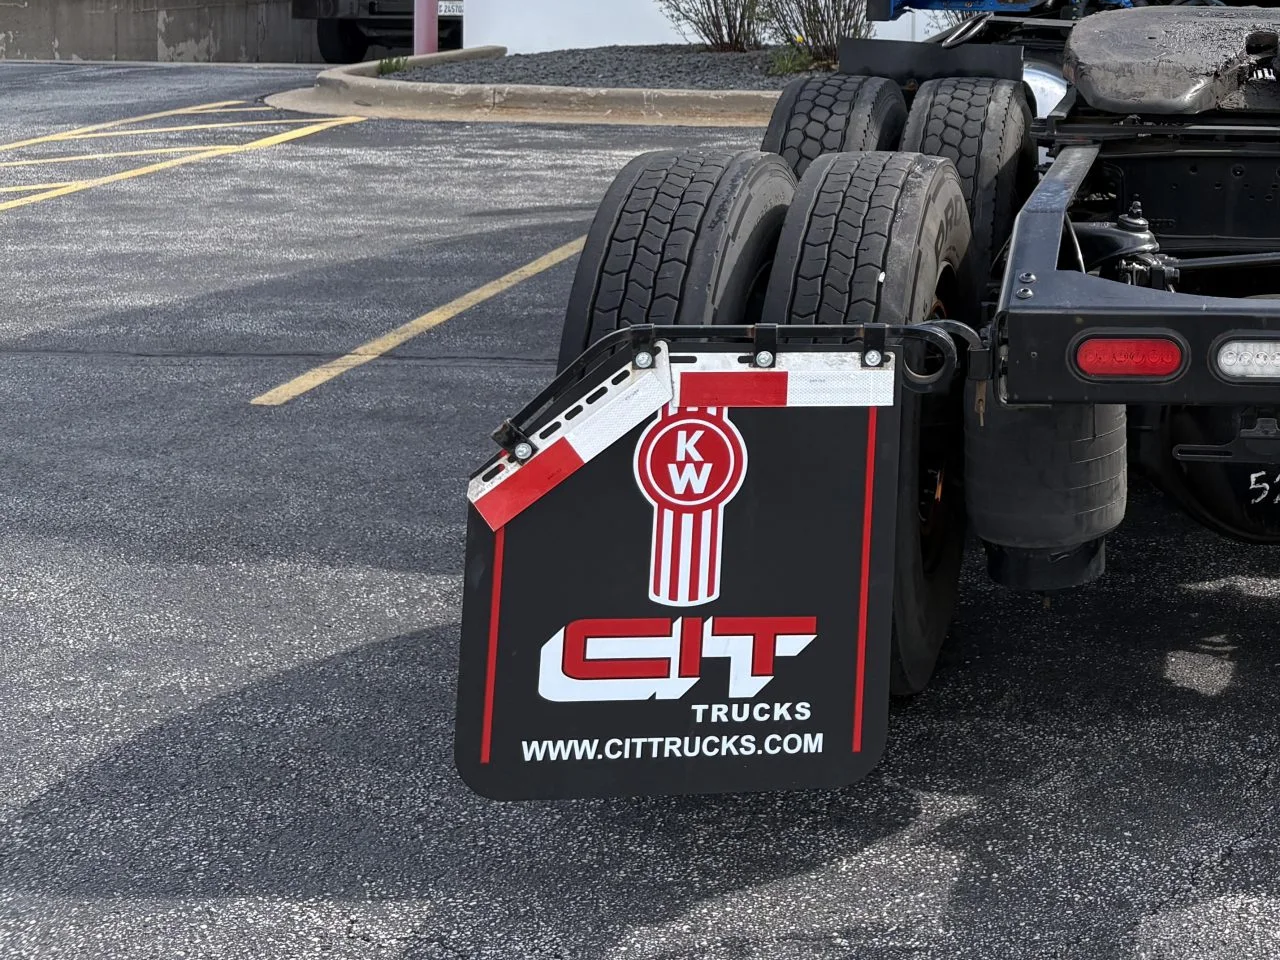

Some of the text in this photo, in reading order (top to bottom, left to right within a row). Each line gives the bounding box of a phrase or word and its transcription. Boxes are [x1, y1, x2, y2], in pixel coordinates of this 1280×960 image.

[538, 616, 818, 702] CIT
[692, 702, 811, 722] TRUCKS
[522, 733, 824, 761] WWW.CITTRUCKS.COM
